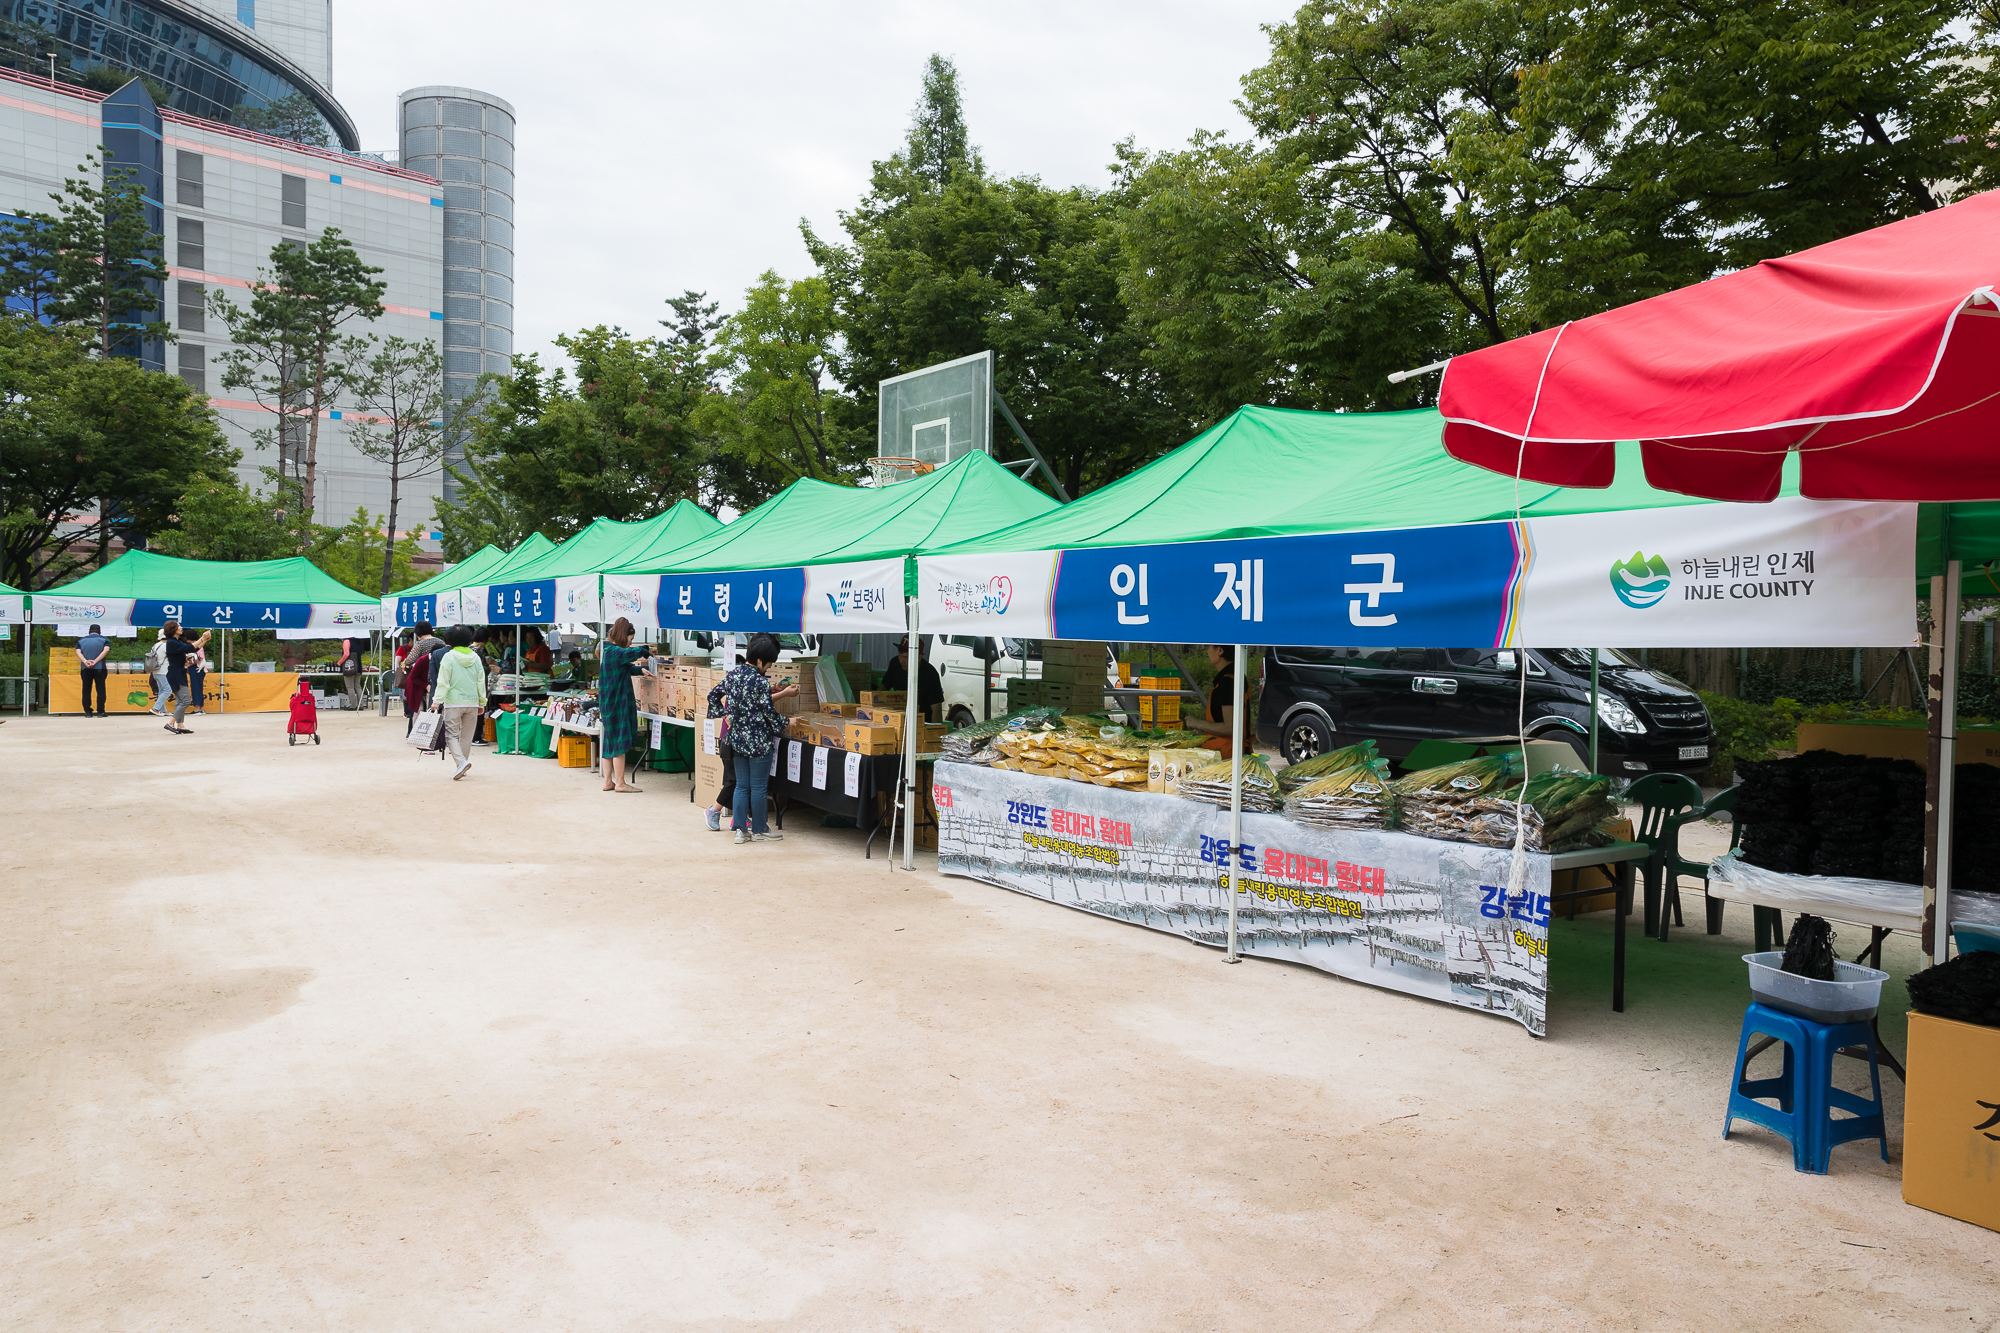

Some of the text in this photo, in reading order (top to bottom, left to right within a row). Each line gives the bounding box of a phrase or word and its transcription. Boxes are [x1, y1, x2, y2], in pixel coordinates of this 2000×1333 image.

[1681, 550, 1815, 580] 하늘내린 인제
[852, 587, 885, 612] 보령시
[1684, 580, 1815, 601] INJE COUNTY
[353, 614, 375, 623] 익산시
[1006, 800, 1133, 846] 강원도 용대리 황태
[1263, 847, 1329, 887] 용대리
[1334, 860, 1386, 898] 황태
